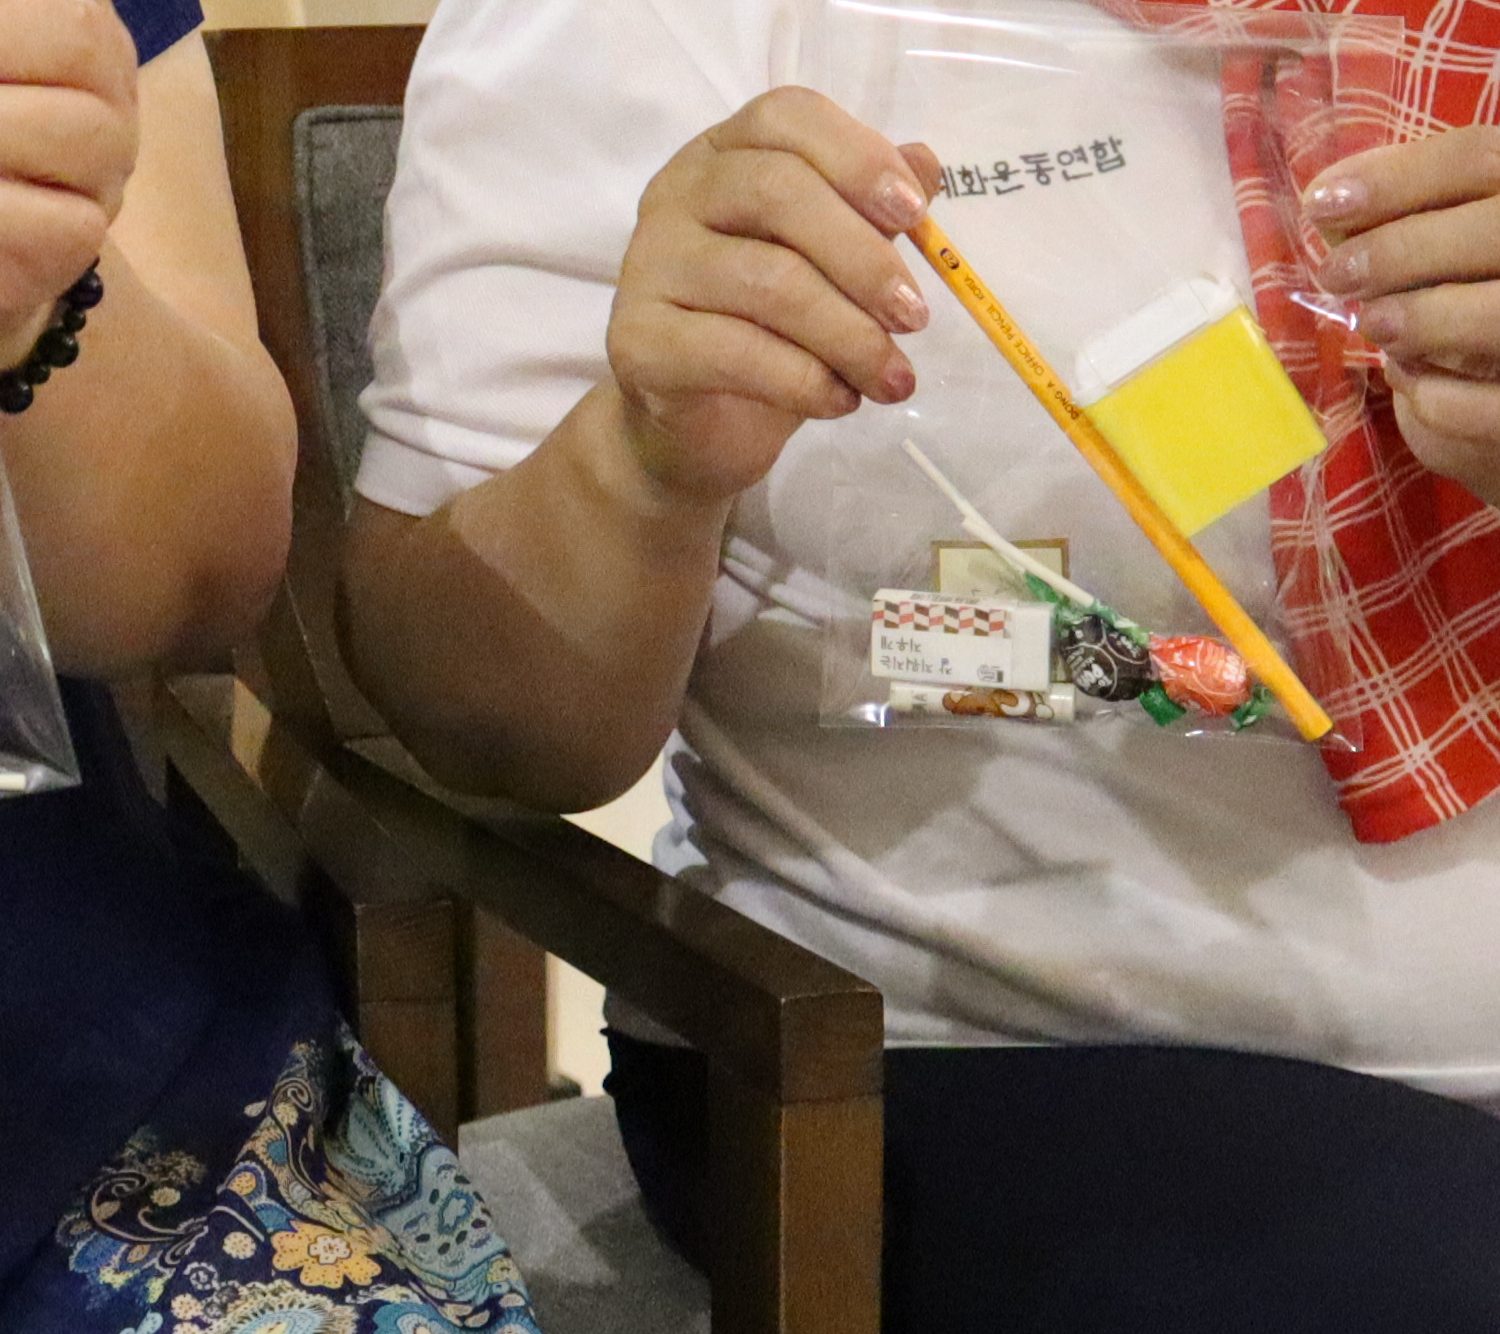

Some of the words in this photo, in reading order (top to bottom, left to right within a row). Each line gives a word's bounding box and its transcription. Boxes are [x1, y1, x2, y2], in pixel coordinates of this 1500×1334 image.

[986, 303, 1016, 341] PENCIL
[1013, 339, 1045, 377] OFFICE
[880, 635, 922, 652] 지우개
